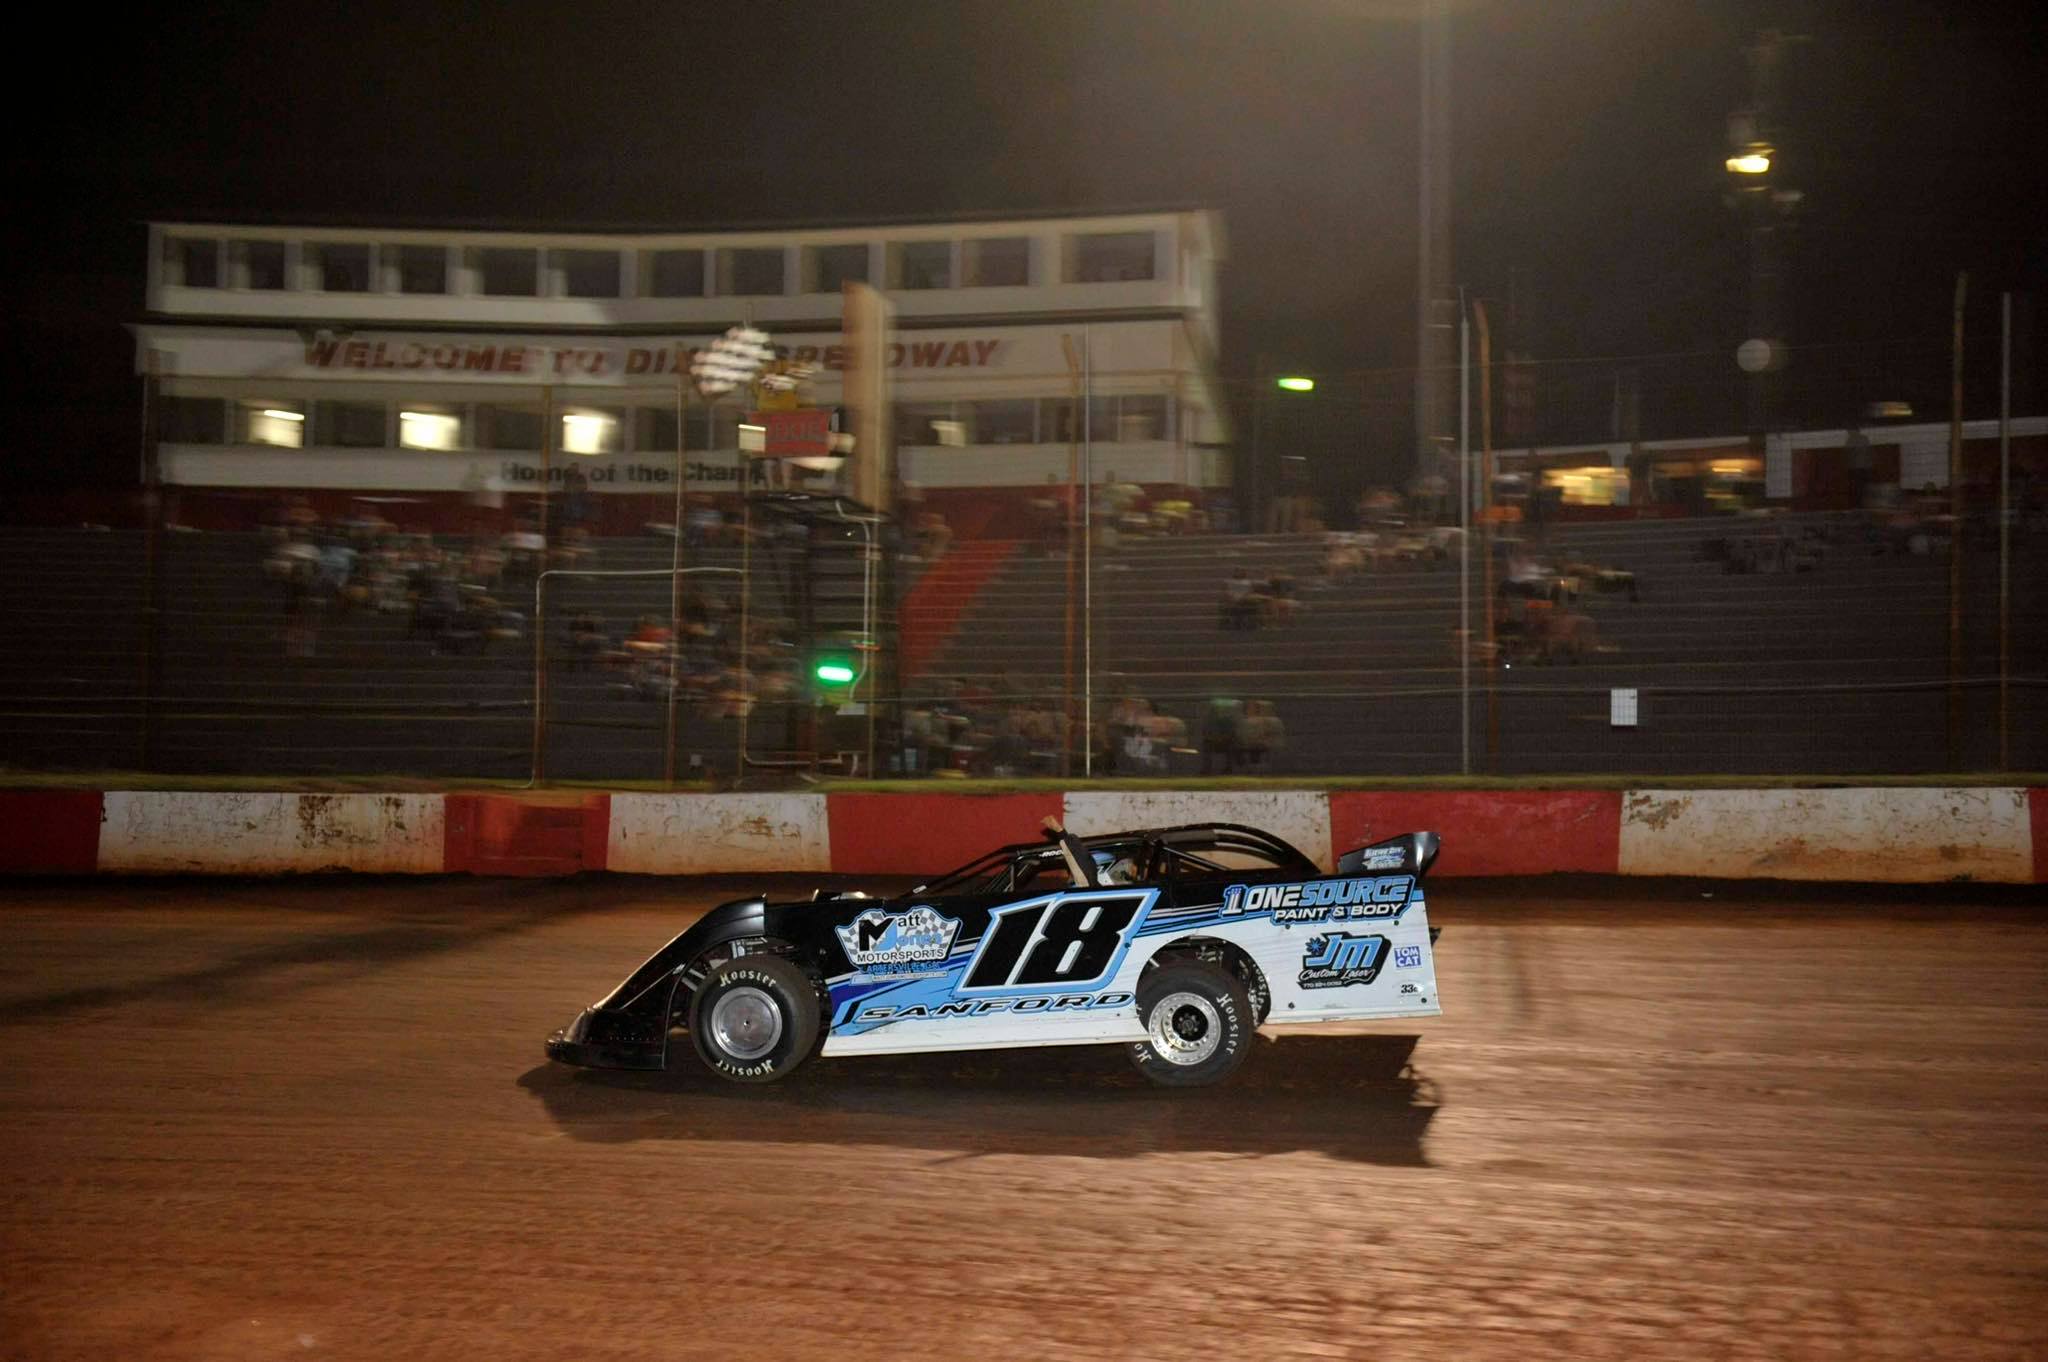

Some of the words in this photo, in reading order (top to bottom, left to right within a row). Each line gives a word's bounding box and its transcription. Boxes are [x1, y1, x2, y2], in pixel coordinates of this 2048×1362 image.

[305, 340, 529, 375] WELCOME
[552, 348, 608, 375] TO
[590, 462, 616, 482] of
[627, 462, 671, 482] the
[1274, 906, 1328, 922] PAINT
[1333, 905, 1346, 917] &
[1350, 903, 1403, 917] BODY
[964, 896, 1147, 988] 18
[857, 948, 945, 963] MOTORSPORTS
[1395, 947, 1419, 957] TOM
[1397, 956, 1419, 967] CAT
[719, 969, 777, 988] Hoosier
[1299, 969, 1338, 981] Custom
[1341, 969, 1376, 982] Laser
[856, 991, 1136, 1023] SANFORD
[1216, 993, 1240, 1056] Hoosier
[715, 1059, 775, 1077] Hoosier
